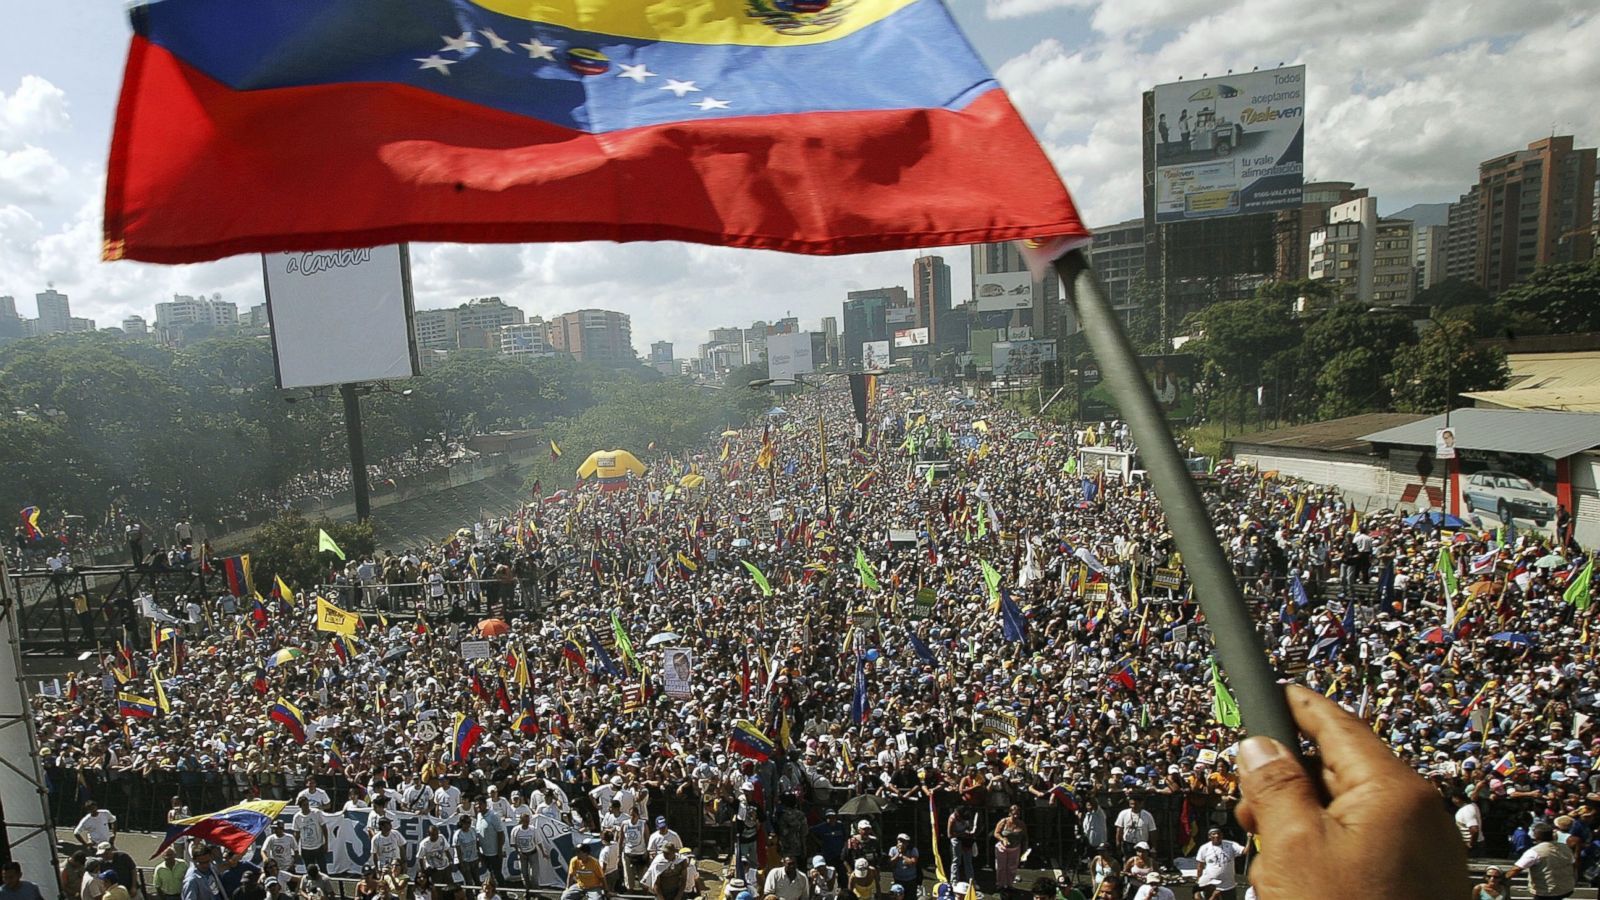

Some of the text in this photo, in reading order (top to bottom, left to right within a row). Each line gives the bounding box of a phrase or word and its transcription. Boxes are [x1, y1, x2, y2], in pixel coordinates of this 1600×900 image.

[1273, 74, 1300, 86] Todos
[1251, 90, 1300, 104] aceptamos
[1242, 155, 1274, 167] tu vale
[1241, 161, 1302, 178] alimentación
